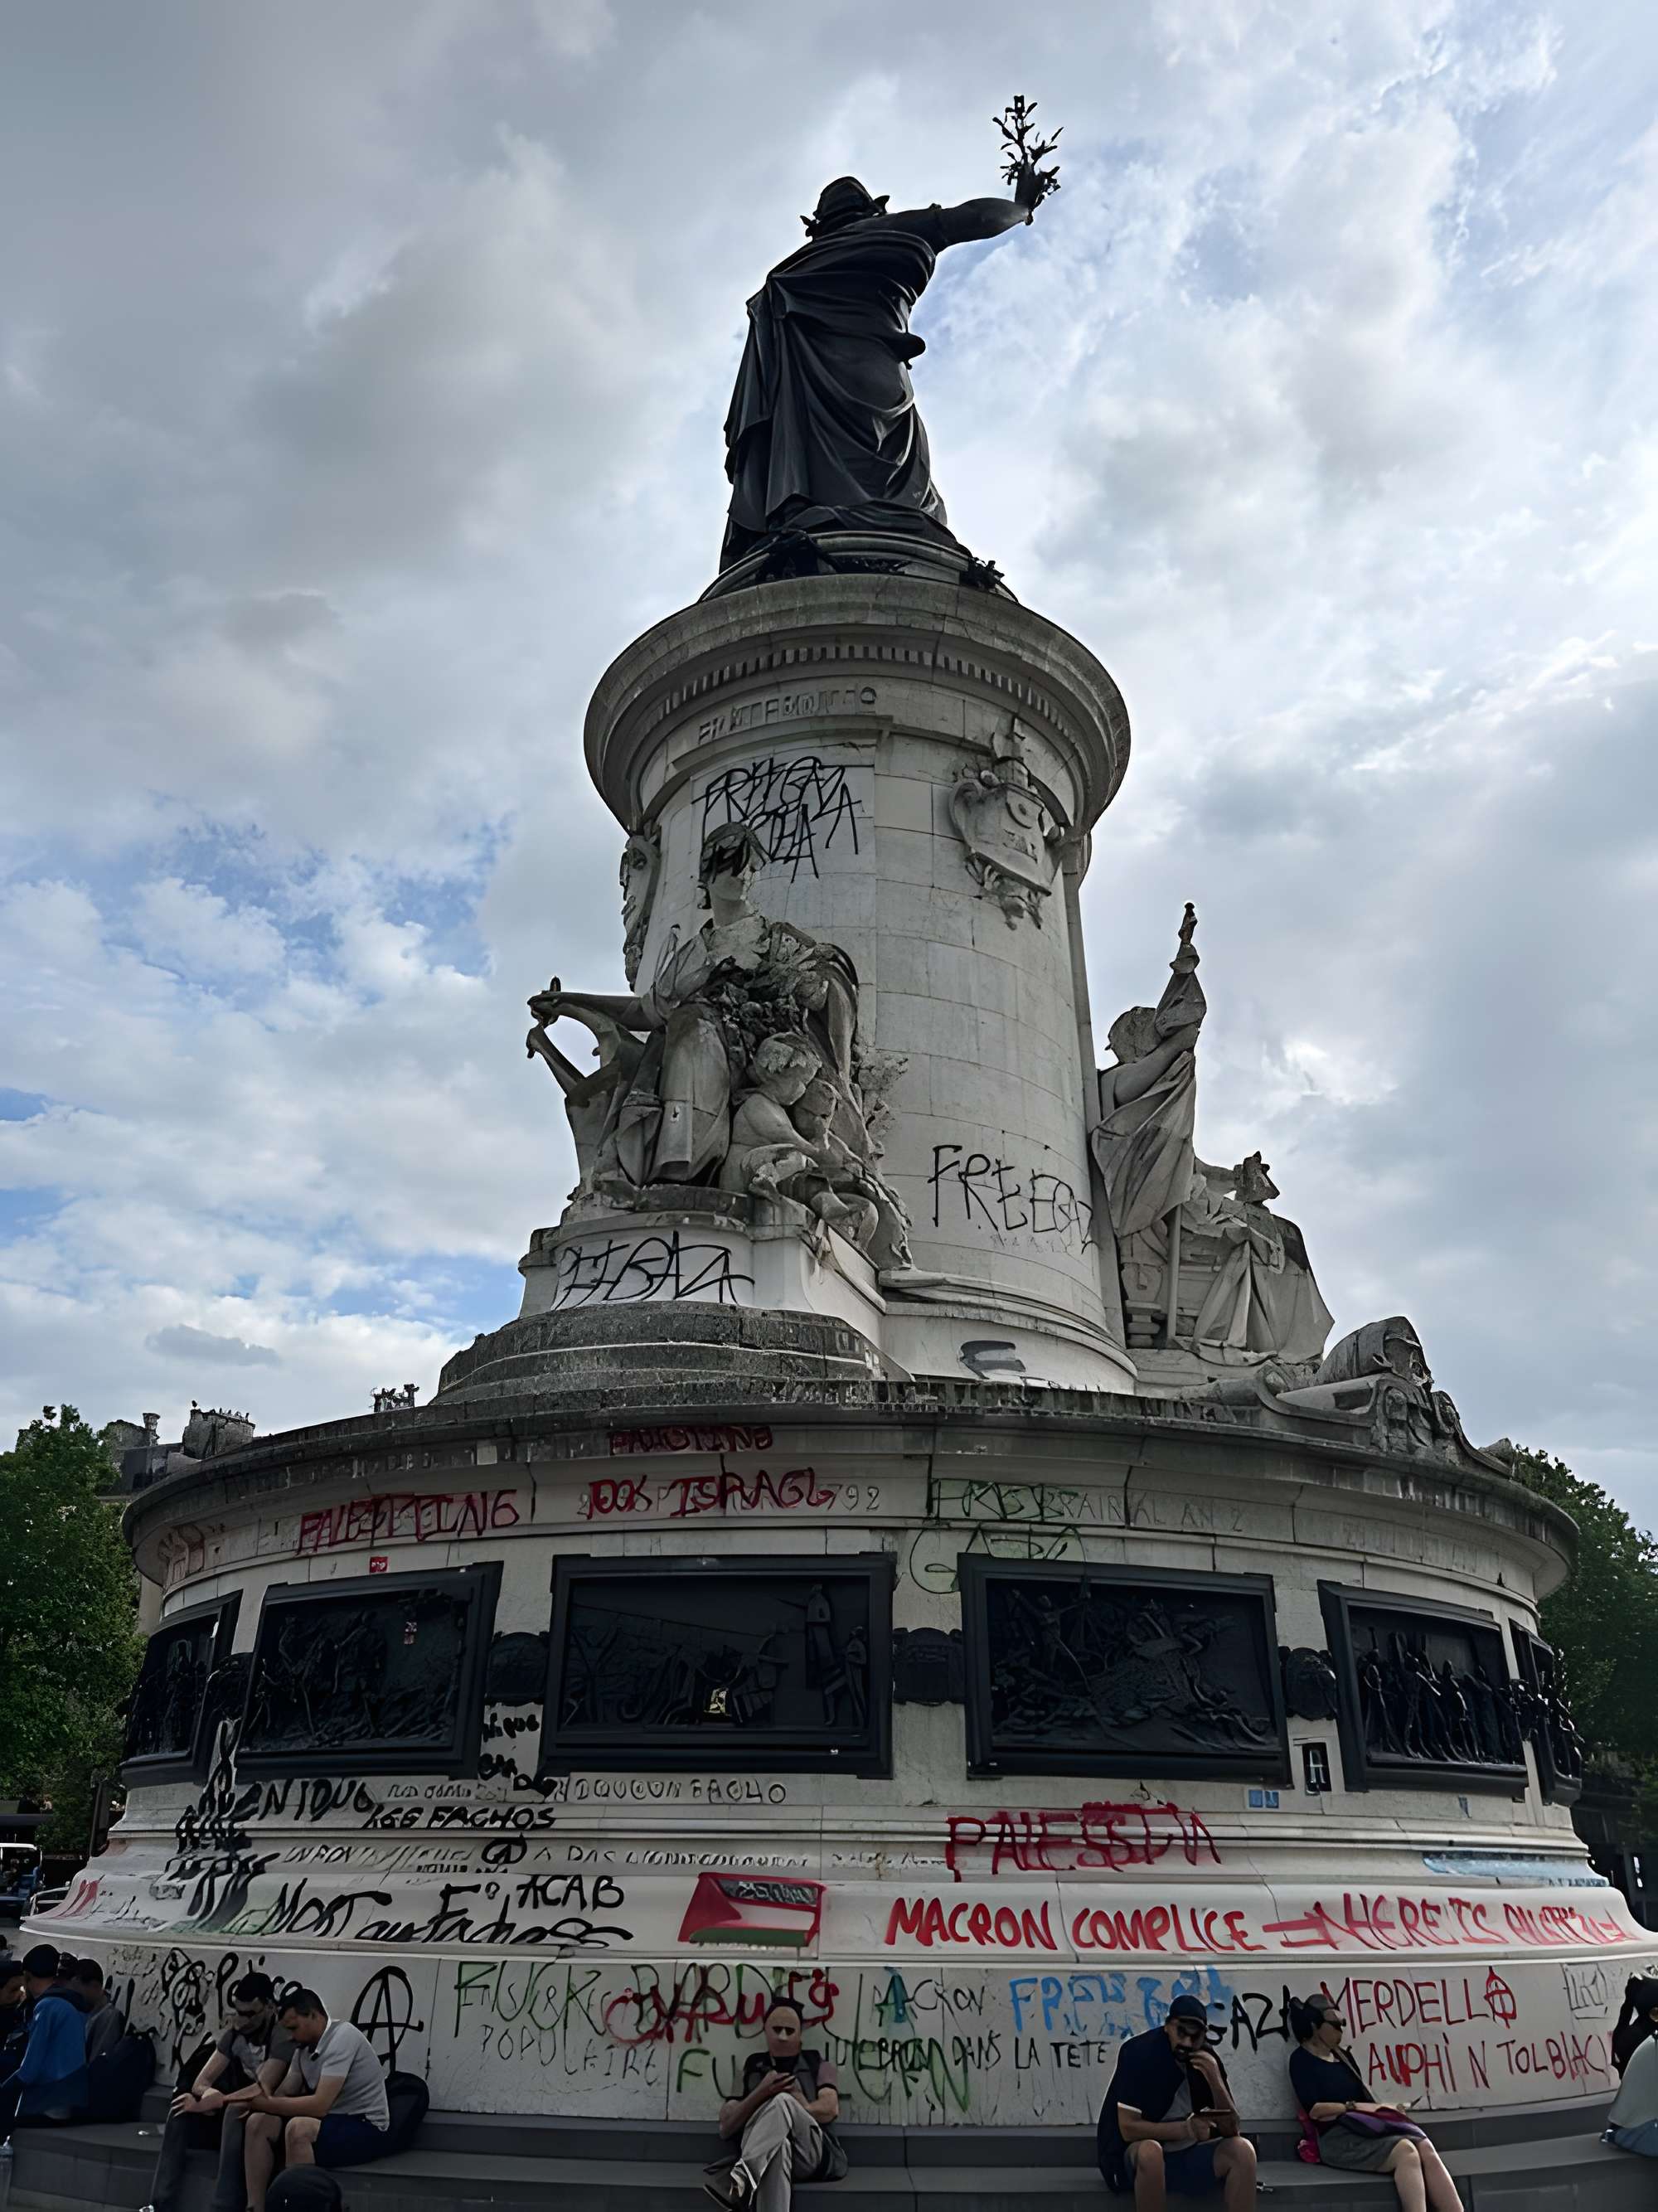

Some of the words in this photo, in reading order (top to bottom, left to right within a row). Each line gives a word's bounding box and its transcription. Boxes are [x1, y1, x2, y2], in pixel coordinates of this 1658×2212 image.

[516, 1875, 625, 1911] ACAB
[884, 1897, 1058, 1950] MACRON
[1071, 1902, 1268, 1954] COMPLICE
[1013, 2036, 1041, 2069] LA
